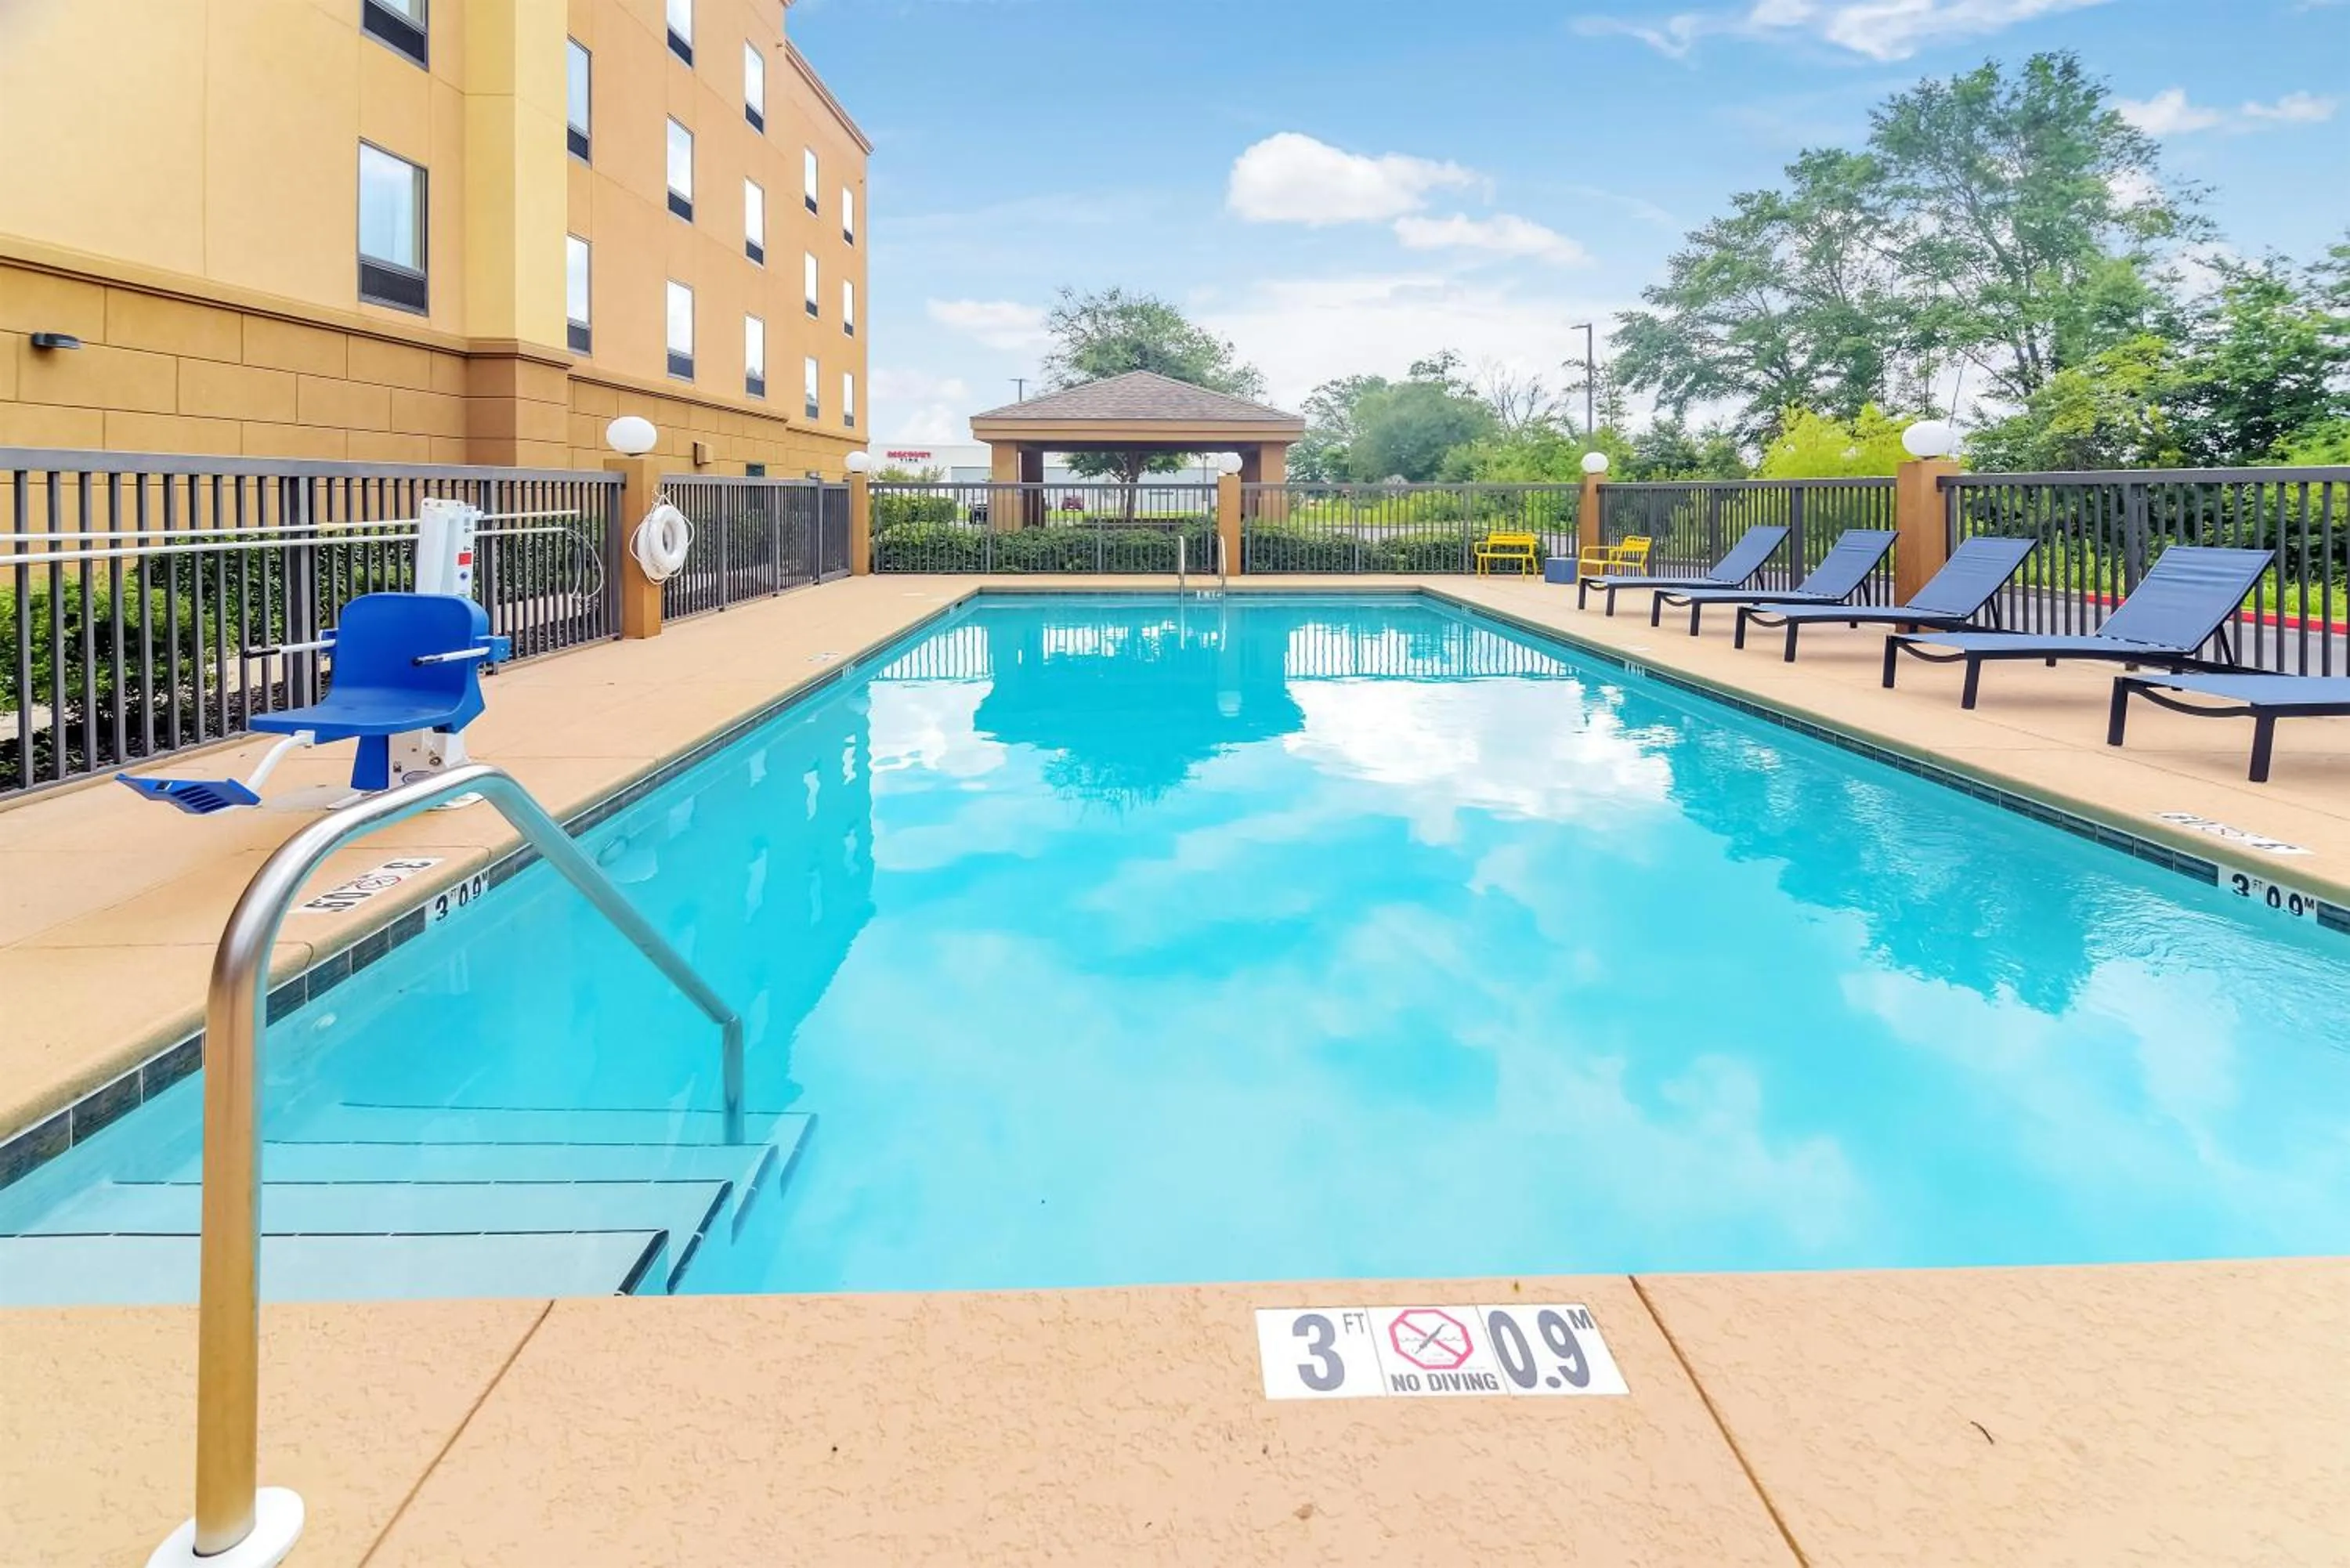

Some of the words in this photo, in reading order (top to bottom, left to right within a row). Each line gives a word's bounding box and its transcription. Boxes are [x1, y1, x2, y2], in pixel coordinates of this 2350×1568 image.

[2232, 873, 2250, 897] 3
[436, 894, 449, 921] 3
[1292, 1313, 1345, 1391] 3
[1343, 1313, 1365, 1335] FT
[1488, 1309, 1592, 1389] 0.9
[1390, 1374, 1422, 1392] NO
[1426, 1373, 1500, 1392] DIVING
